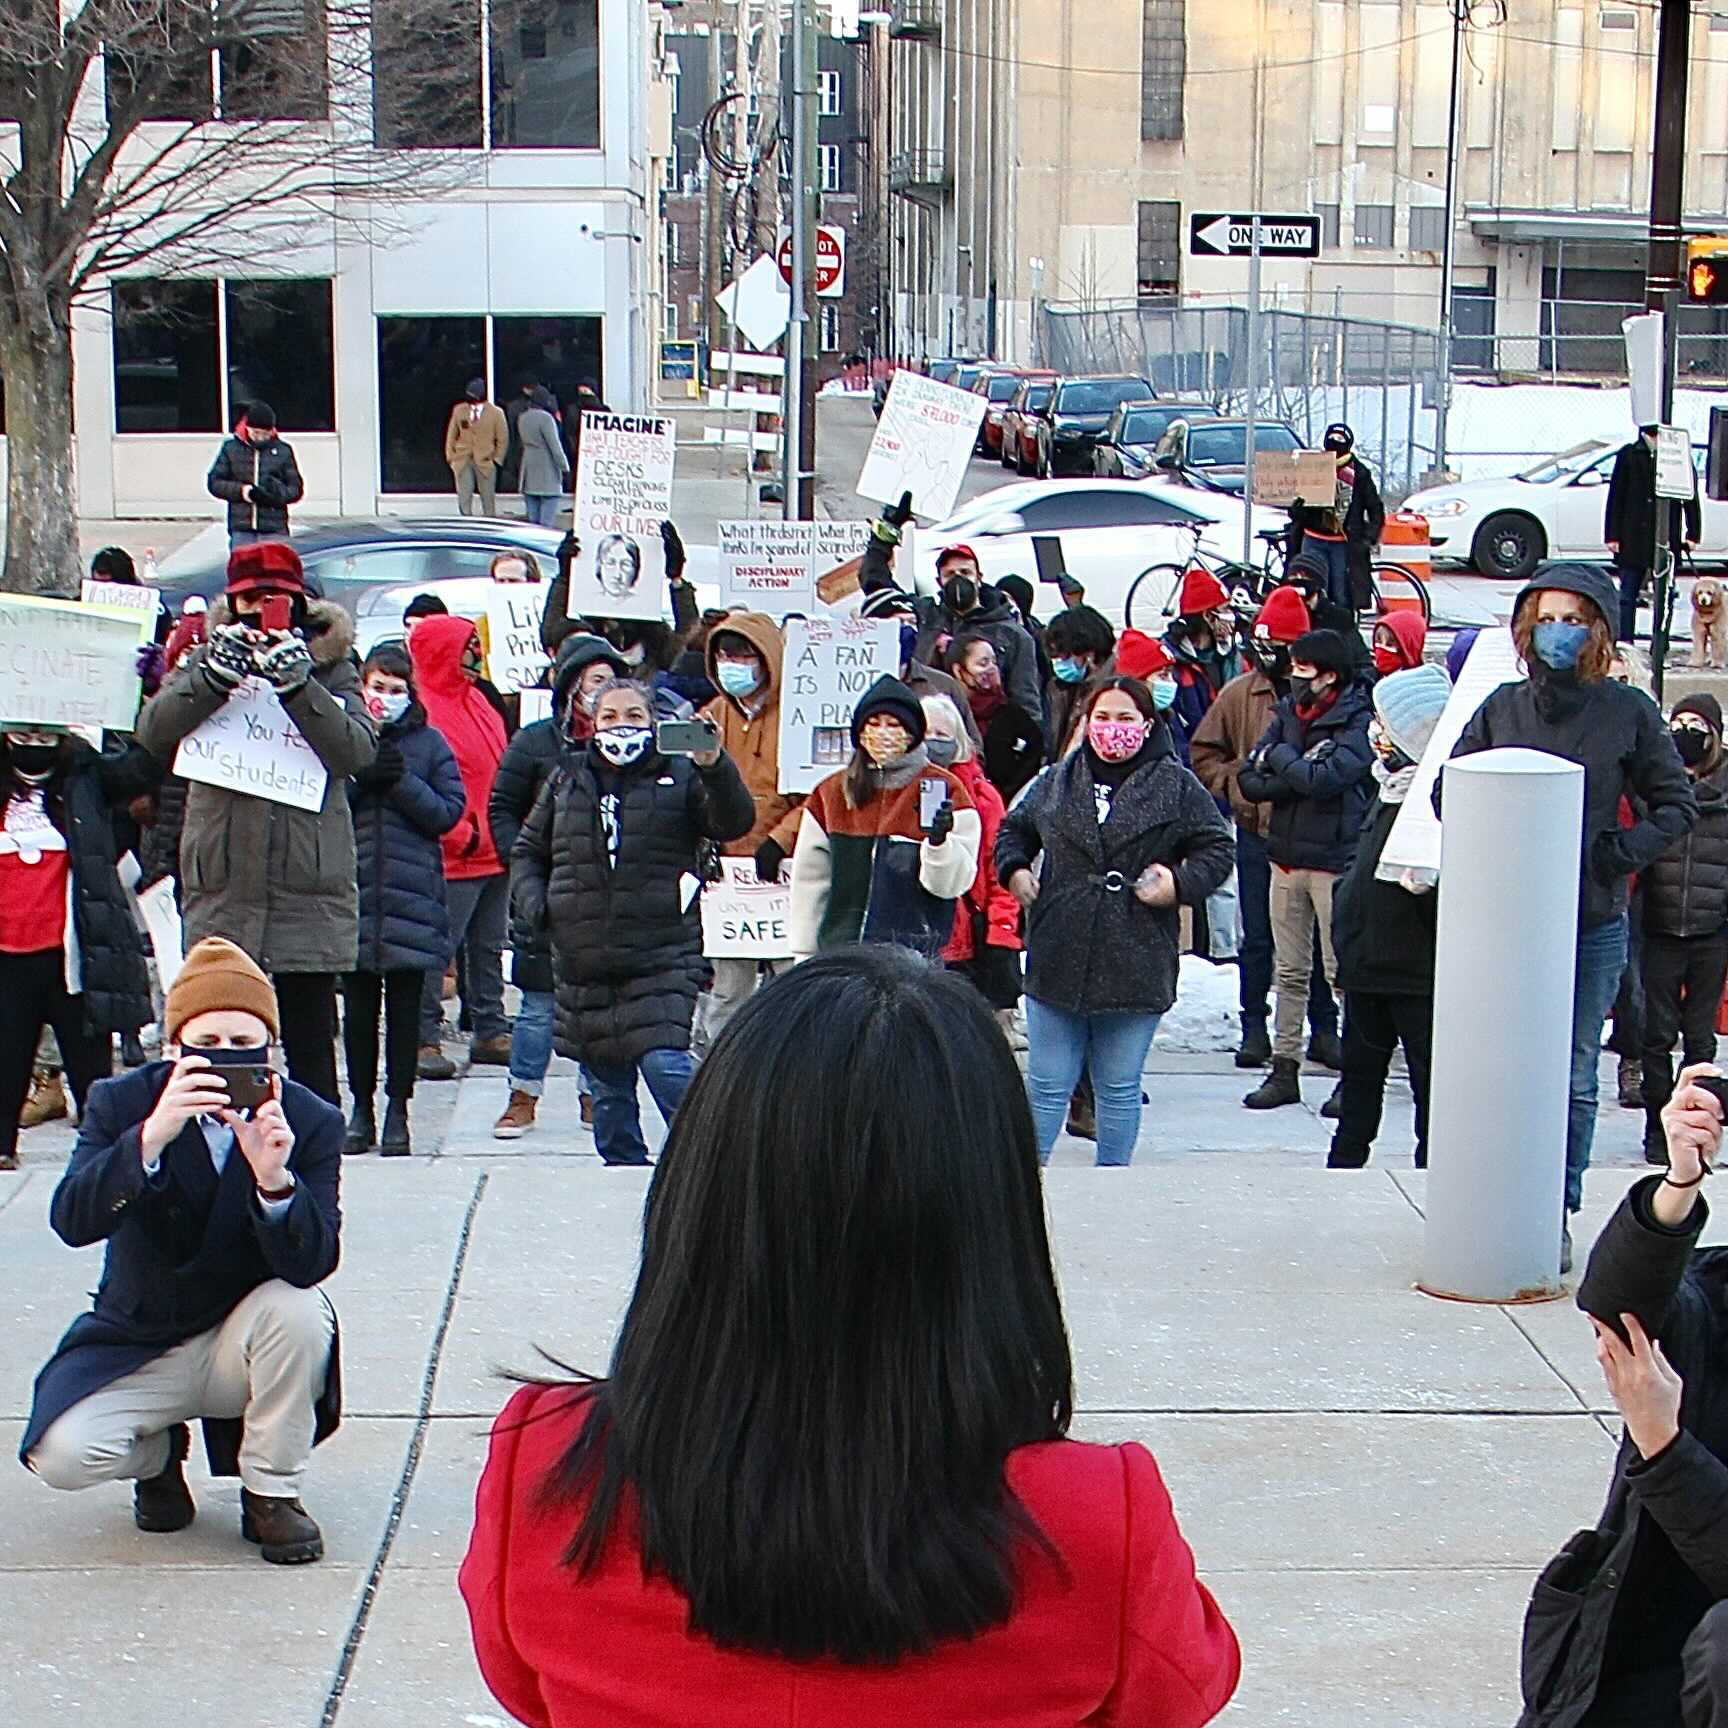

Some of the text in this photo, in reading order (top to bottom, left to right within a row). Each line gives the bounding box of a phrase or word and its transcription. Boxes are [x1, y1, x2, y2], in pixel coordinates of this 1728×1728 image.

[1270, 227, 1307, 245] WAY
[593, 459, 645, 480] DESKS
[747, 577, 790, 590] ACTION
[797, 644, 875, 668] A FAN
[791, 669, 881, 696] IS NOT
[721, 919, 788, 941] SAFE
